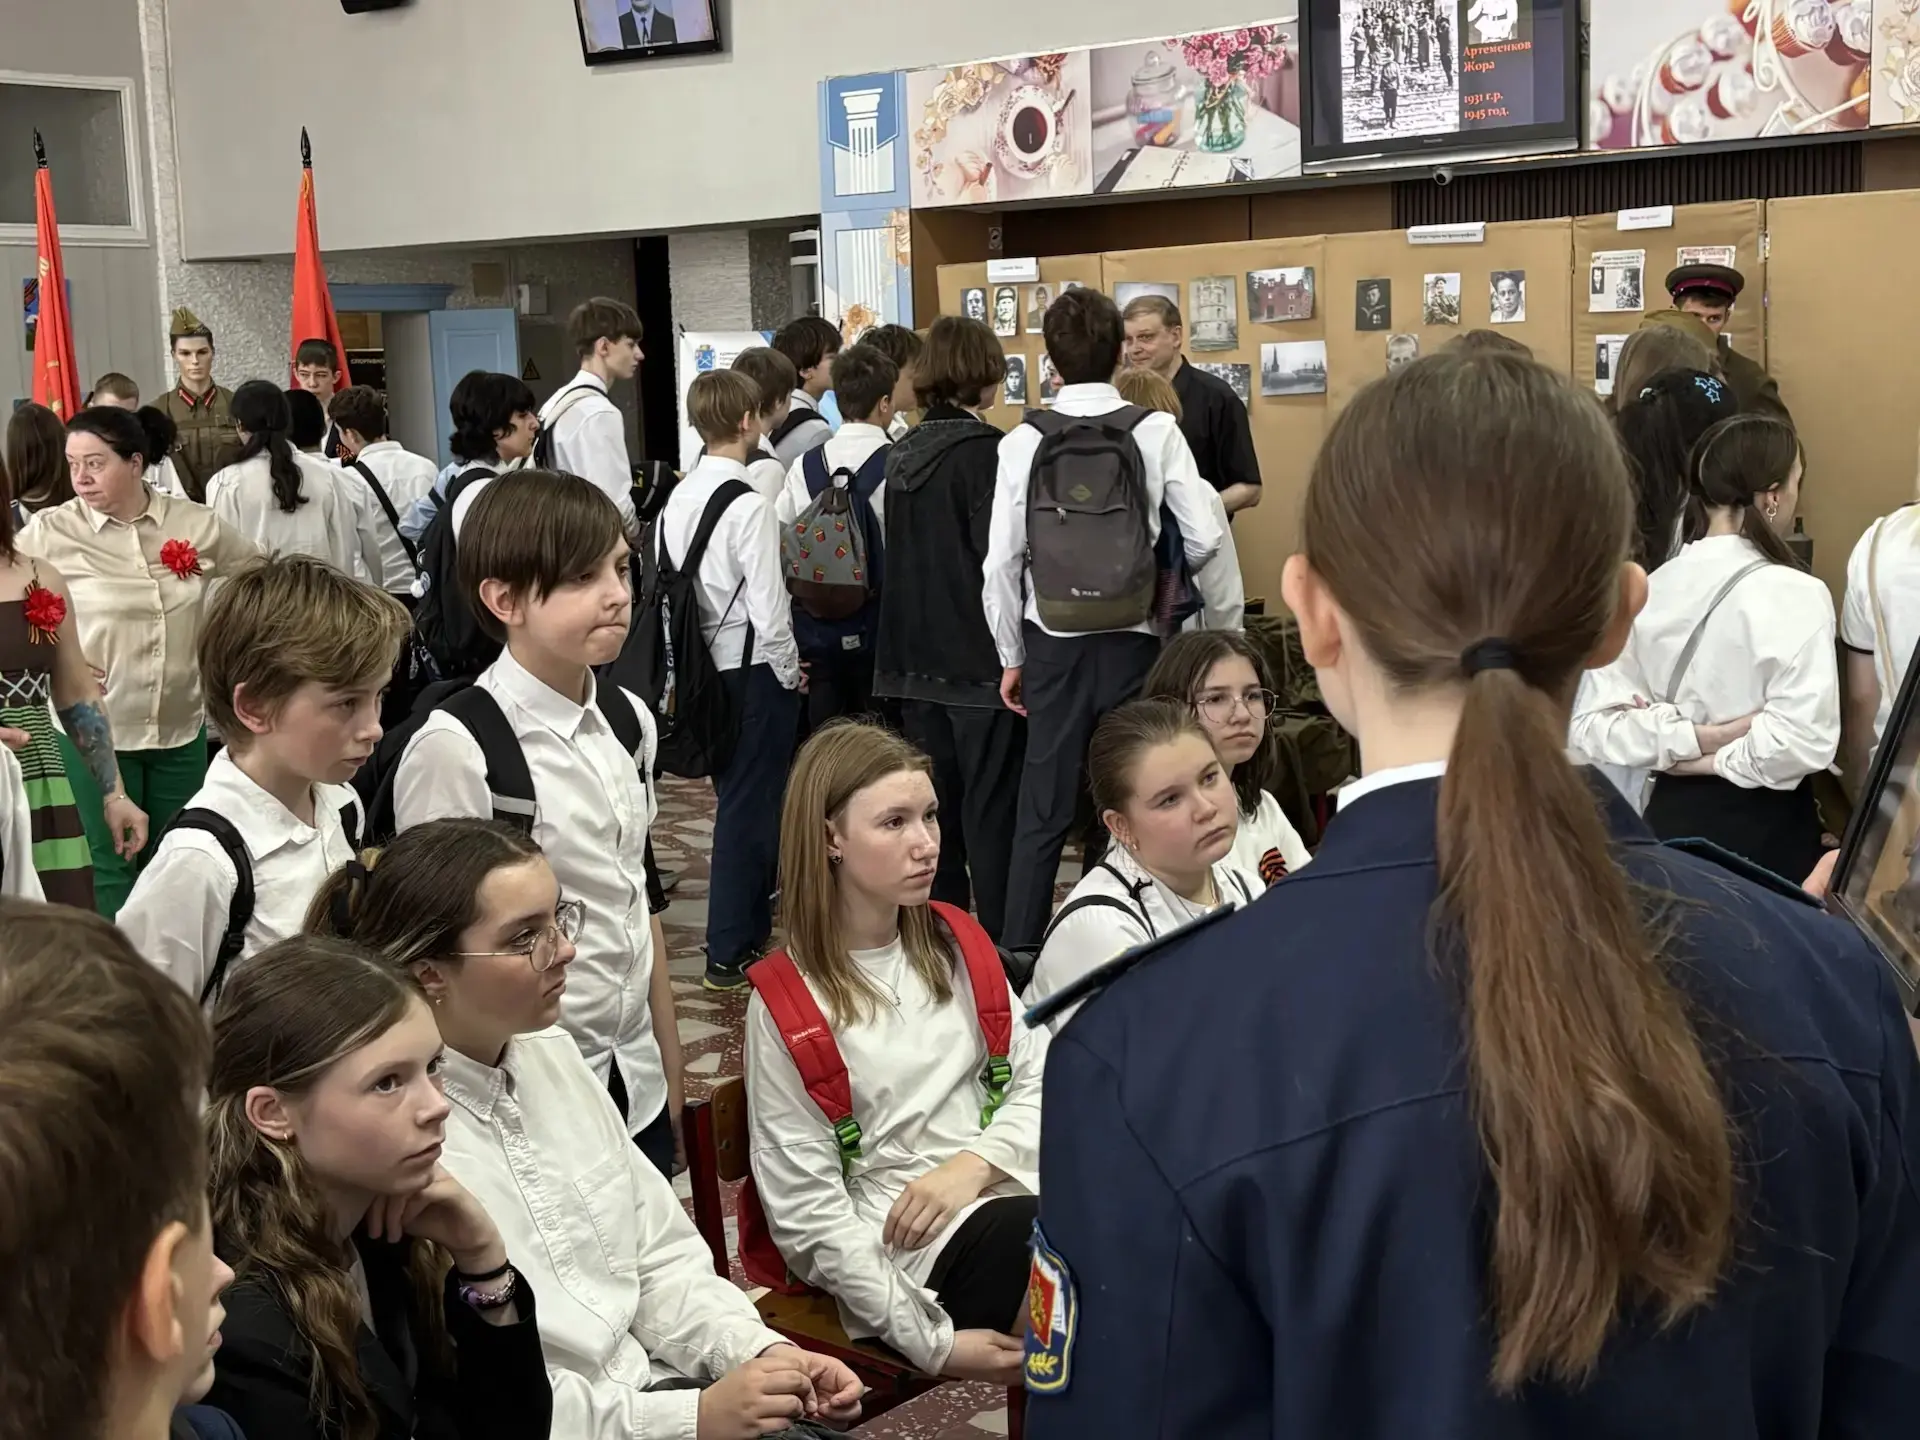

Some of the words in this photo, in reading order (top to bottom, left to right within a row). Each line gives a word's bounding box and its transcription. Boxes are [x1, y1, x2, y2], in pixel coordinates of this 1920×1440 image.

[1463, 41, 1532, 58] Артеменков
[1464, 61, 1496, 73] Жора
[1464, 93, 1483, 105] 1931
[1486, 92, 1504, 103] г.р.
[1464, 108, 1486, 120] 1945
[1487, 107, 1510, 117] год.
